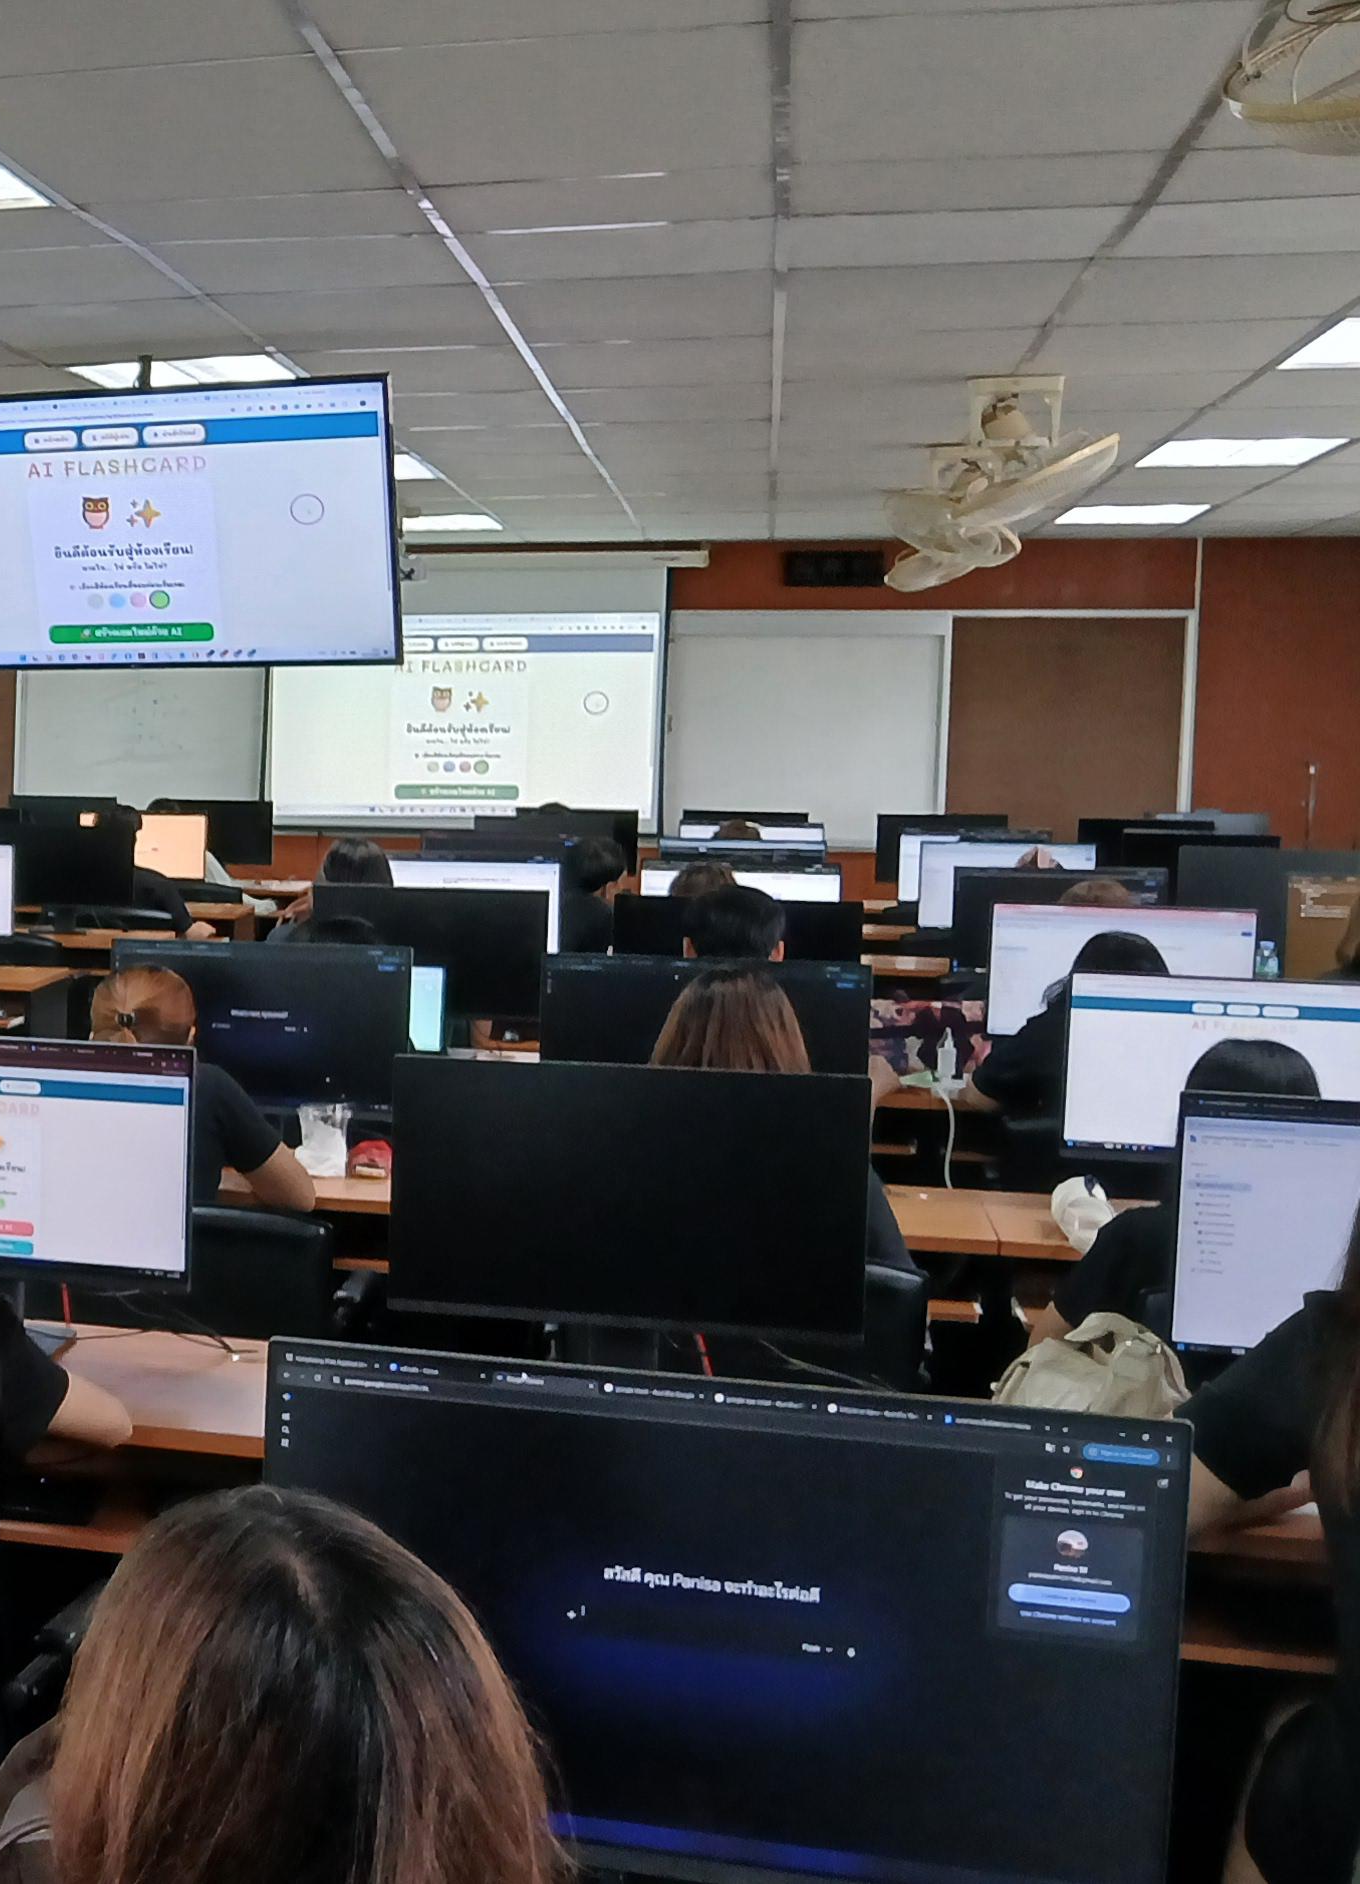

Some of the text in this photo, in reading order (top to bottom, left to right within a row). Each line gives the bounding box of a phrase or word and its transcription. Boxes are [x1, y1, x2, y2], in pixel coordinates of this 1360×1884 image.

[28, 456, 207, 479] AI FLASHCARD
[422, 660, 527, 673] FLASHCARD
[644, 1570, 670, 1588] คุณ
[672, 1573, 721, 1592] Panisa
